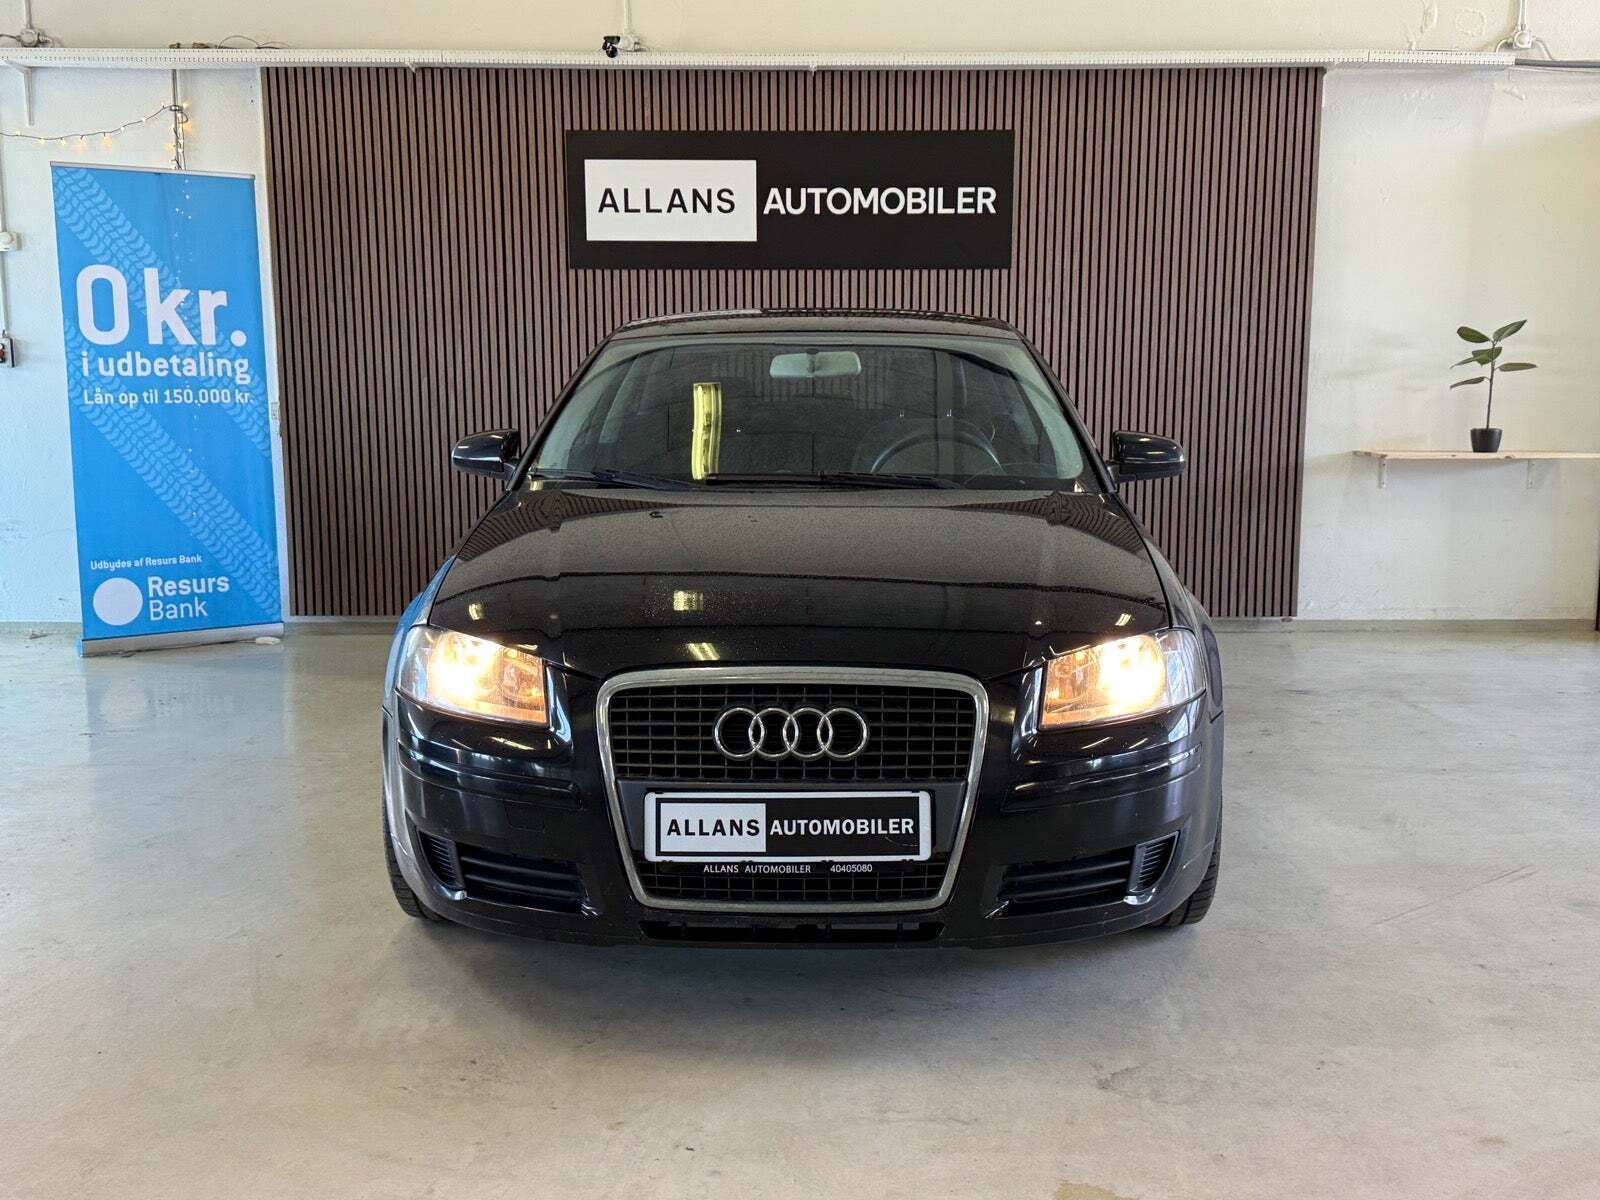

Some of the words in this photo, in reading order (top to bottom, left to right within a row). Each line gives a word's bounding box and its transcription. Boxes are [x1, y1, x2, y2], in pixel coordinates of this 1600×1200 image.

[598, 186, 736, 214] ALLANS
[763, 186, 997, 215] AUTOMOBILER
[75, 263, 131, 346] 0
[143, 266, 248, 347] kr.
[81, 350, 90, 377] i
[98, 351, 251, 385] udbetaling
[83, 387, 114, 405] Lån
[118, 391, 138, 408] op
[143, 389, 159, 404] til
[164, 388, 231, 405] 150.000
[235, 389, 253, 404] kr.
[90, 559, 132, 571] Udbydes
[134, 557, 143, 568] af
[145, 556, 177, 566] Resurs
[179, 554, 202, 563] Bank
[147, 575, 230, 598] Resurs
[149, 596, 208, 621] Bank
[667, 818, 760, 836] ALLANS
[770, 818, 914, 836] AUTOMOBILER
[703, 864, 739, 873] ALLANS
[744, 864, 811, 874] AUTOMOBILER
[830, 863, 873, 873] 40405080
